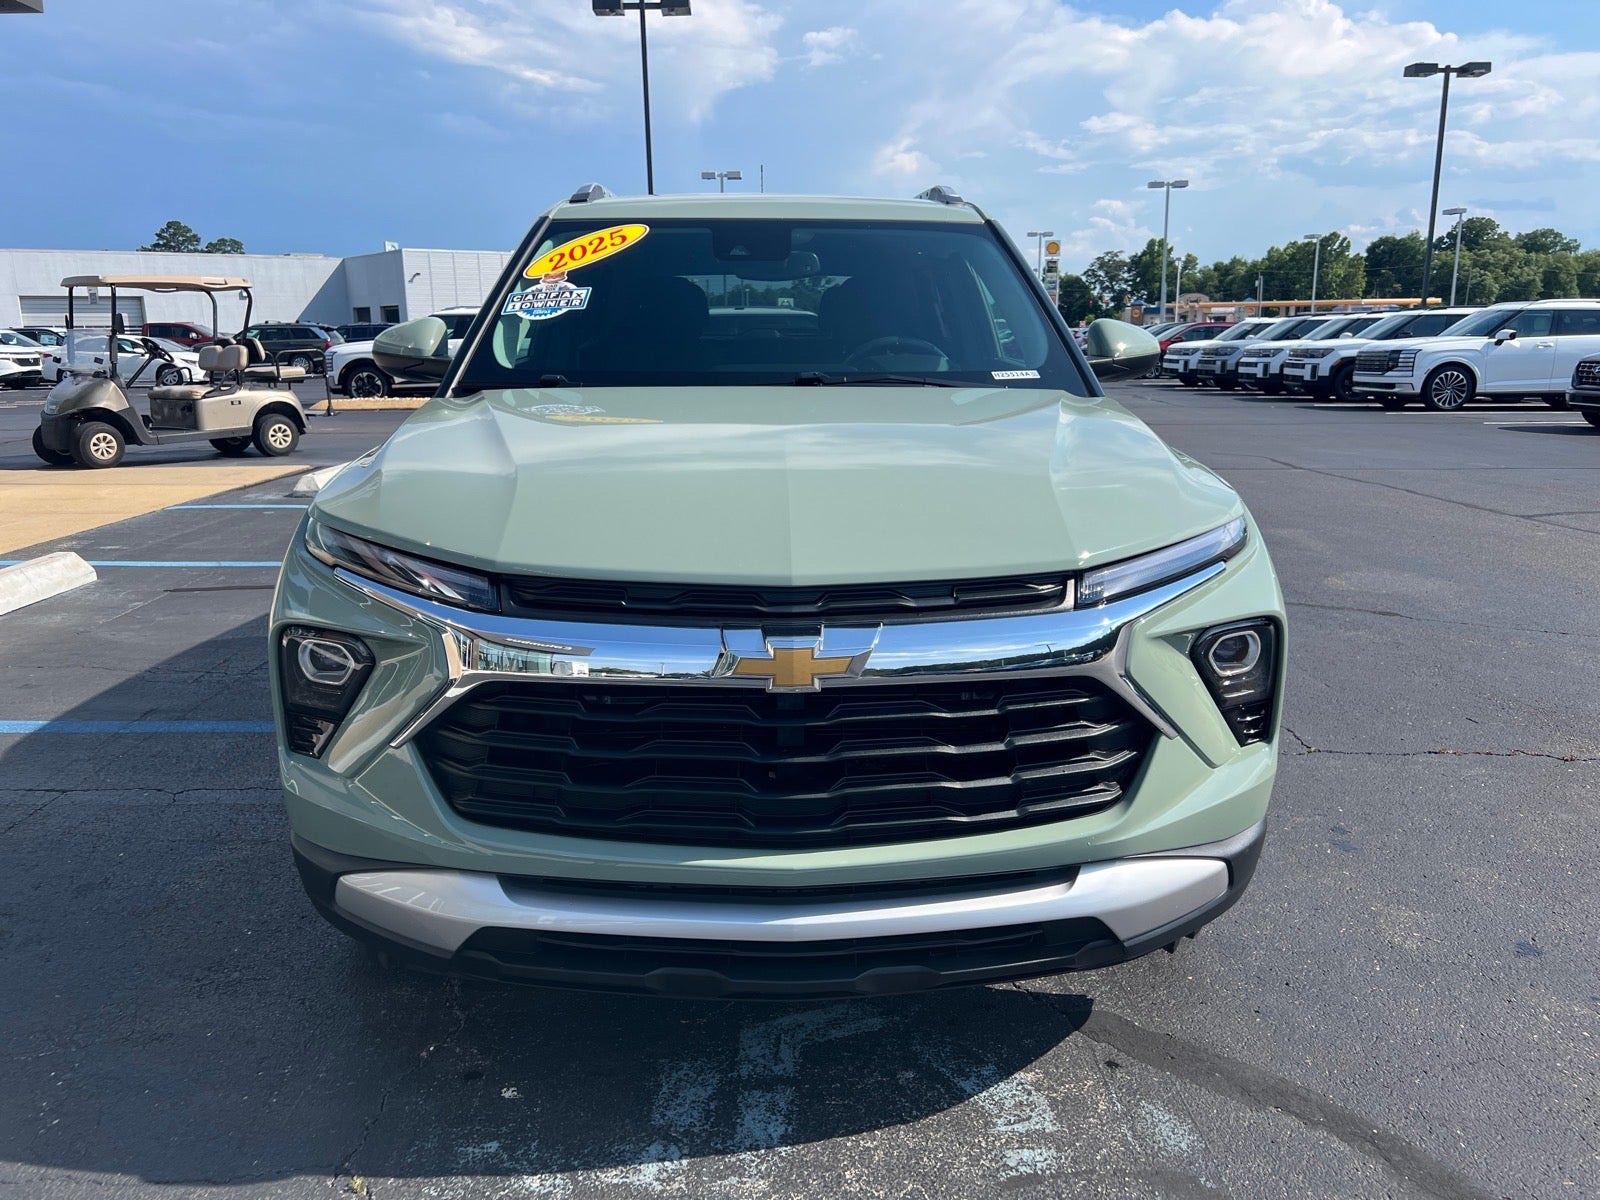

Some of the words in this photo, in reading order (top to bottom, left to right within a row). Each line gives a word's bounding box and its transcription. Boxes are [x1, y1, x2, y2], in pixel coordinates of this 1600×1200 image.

[549, 229, 627, 272] 2025
[511, 290, 584, 302] CARFAX
[521, 299, 582, 309] OWNER
